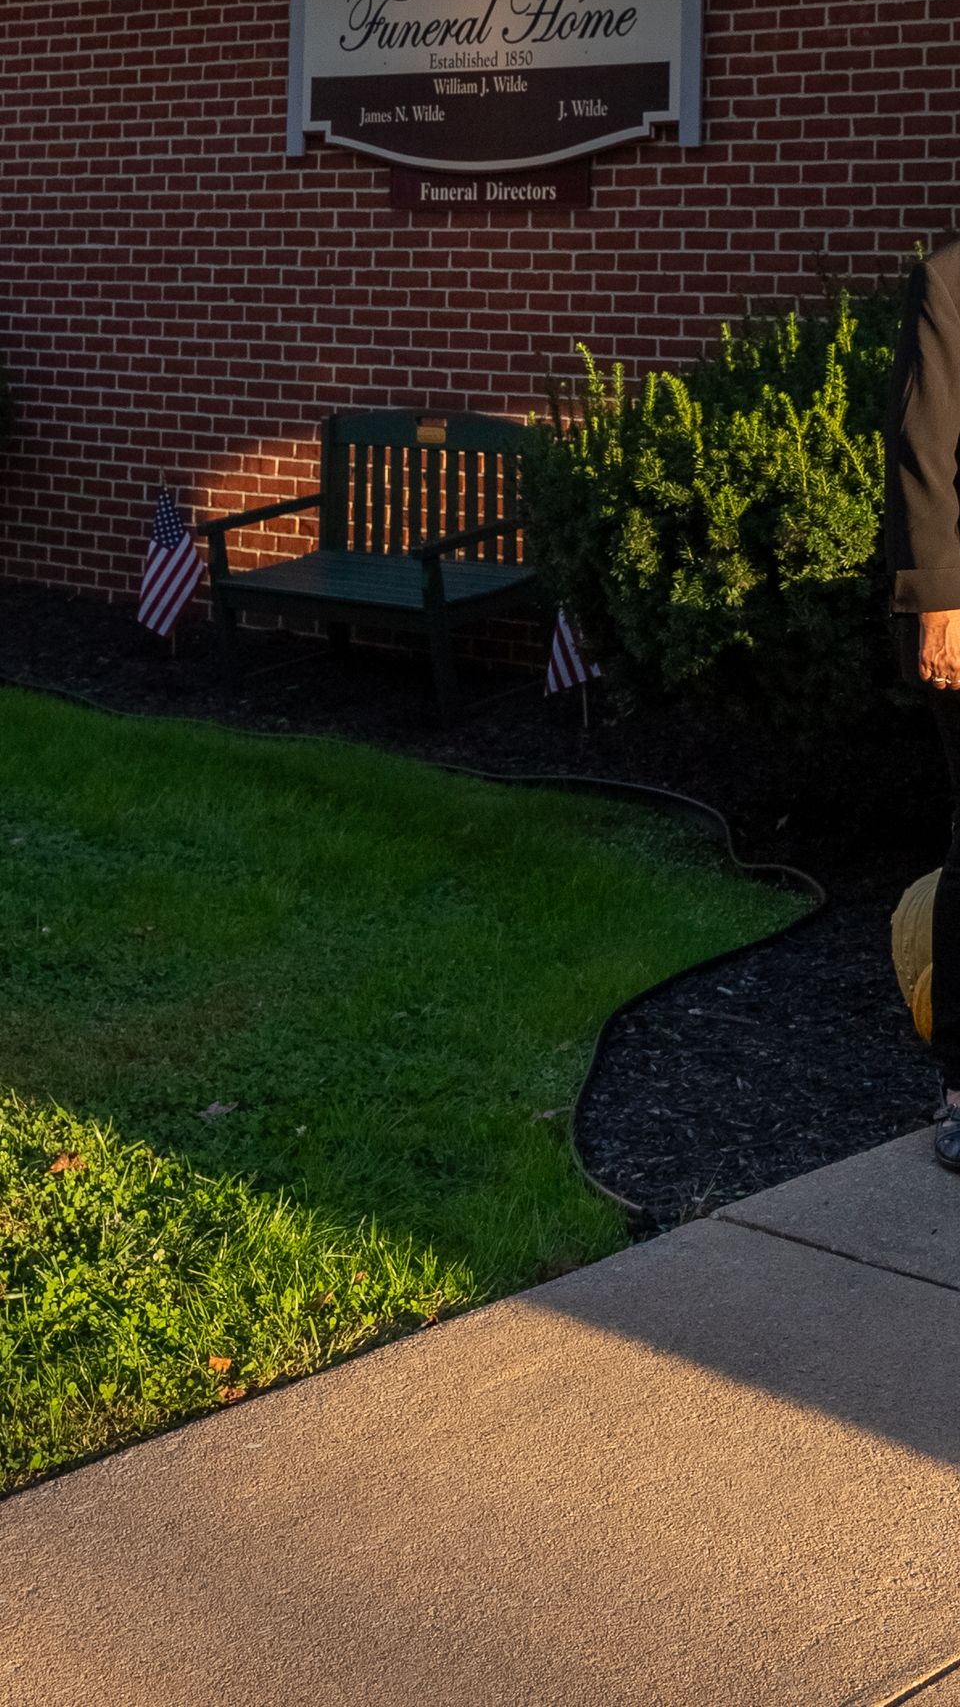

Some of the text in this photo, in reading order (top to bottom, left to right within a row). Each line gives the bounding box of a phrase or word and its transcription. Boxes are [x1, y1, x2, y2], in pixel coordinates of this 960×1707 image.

[429, 50, 533, 70] Established 1850
[433, 75, 528, 98] William J. Wilde
[359, 105, 445, 127] James N. Wilde
[557, 99, 608, 121] J. Wilde
[420, 181, 557, 201] Funeral Directors
